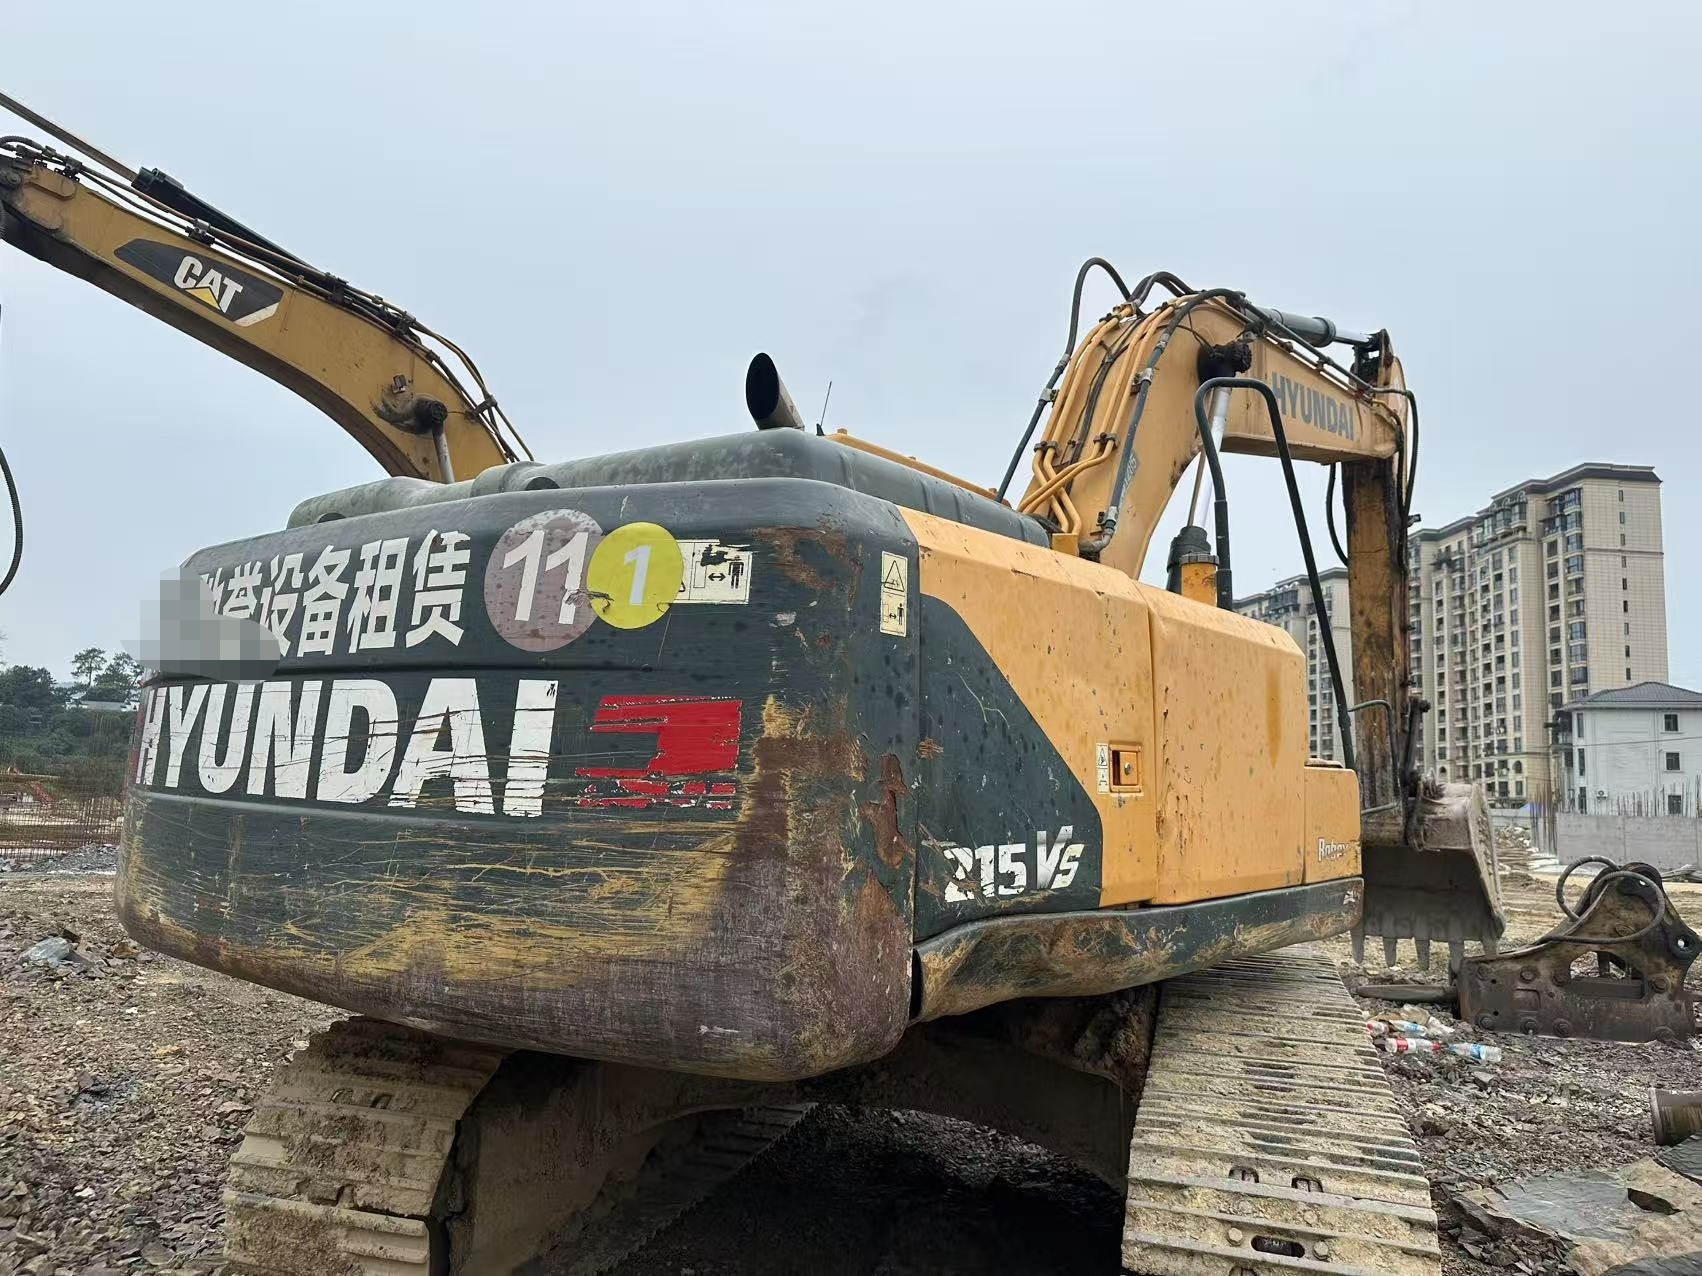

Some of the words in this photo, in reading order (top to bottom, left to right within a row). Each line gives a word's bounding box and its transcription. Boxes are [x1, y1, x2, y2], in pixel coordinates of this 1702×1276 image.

[174, 256, 243, 313] CAT
[1272, 371, 1354, 441] HYUNDAI
[503, 530, 588, 624] 11
[624, 545, 652, 607] 1
[136, 678, 558, 817] HYUNDAI
